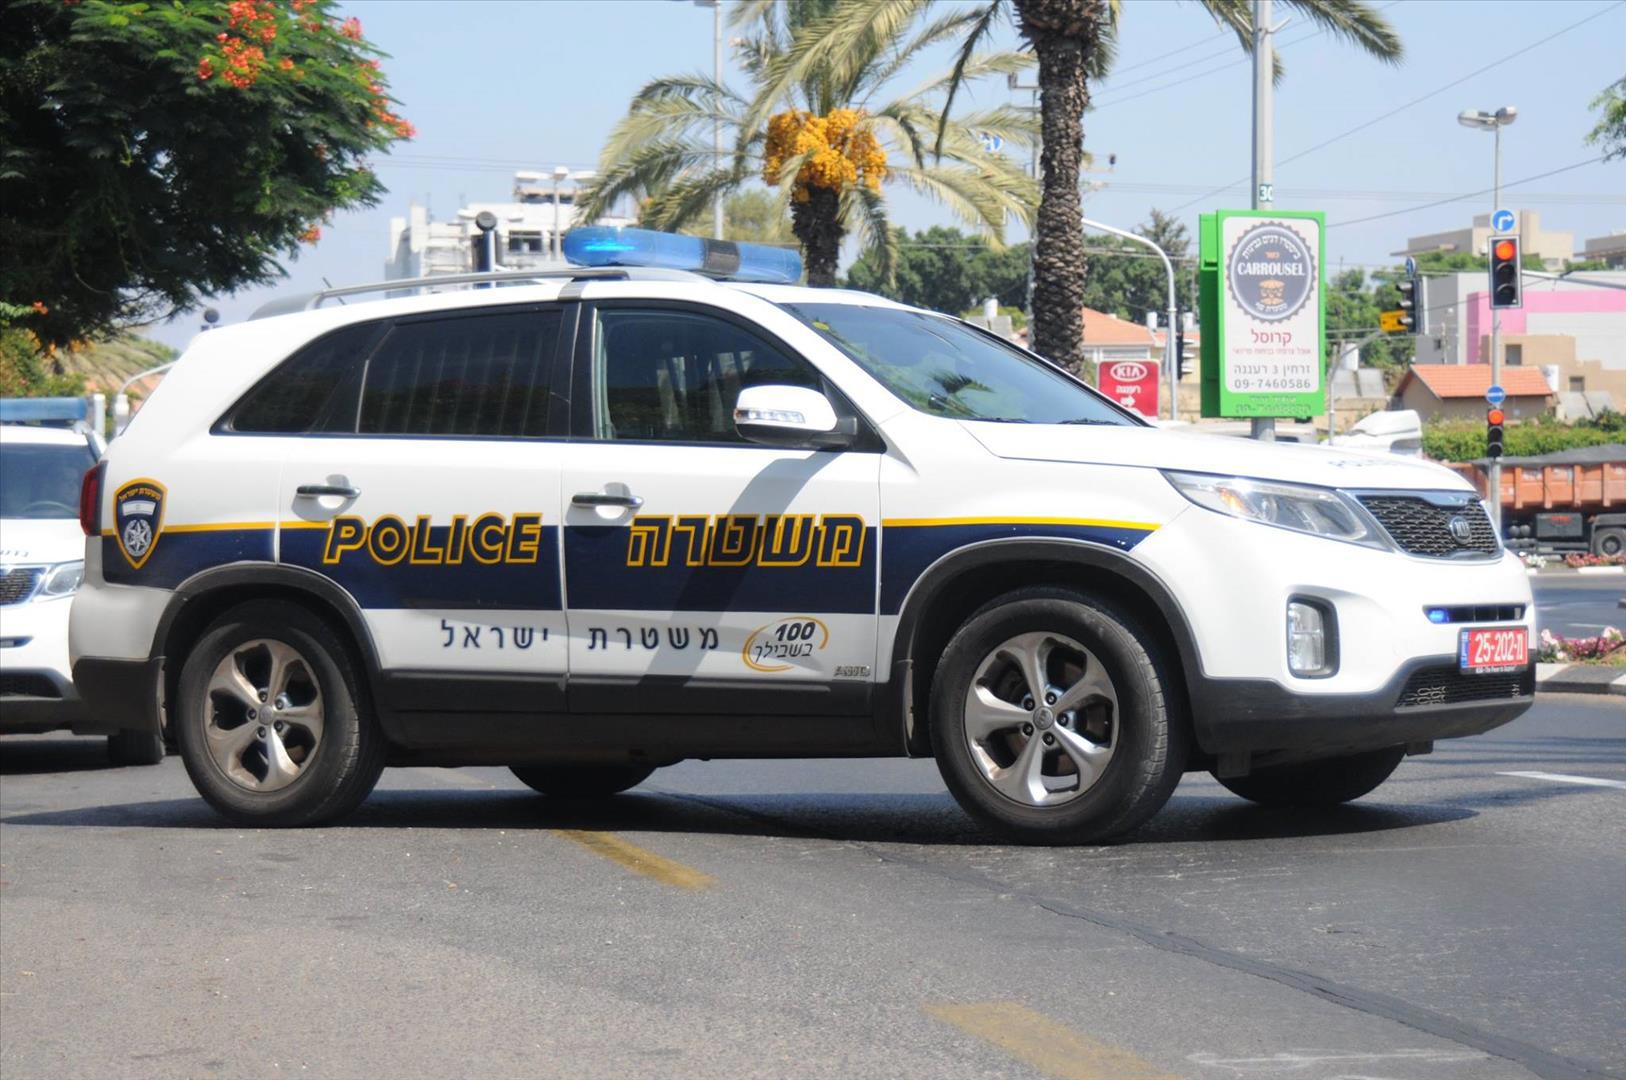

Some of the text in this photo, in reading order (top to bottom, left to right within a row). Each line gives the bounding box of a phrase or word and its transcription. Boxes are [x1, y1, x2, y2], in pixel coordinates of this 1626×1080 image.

[1237, 262, 1305, 276] CARROUSEL
[1251, 328, 1292, 346] קרוסל
[1116, 366, 1140, 377] KIA
[1234, 364, 1268, 375] רעננה
[1234, 378, 1311, 389] 09-7460586
[323, 512, 543, 565] POLICE
[626, 513, 867, 567] משטרה
[440, 619, 719, 650] משטרת ישראל
[775, 621, 816, 642] 100
[755, 641, 813, 663] בשבילך
